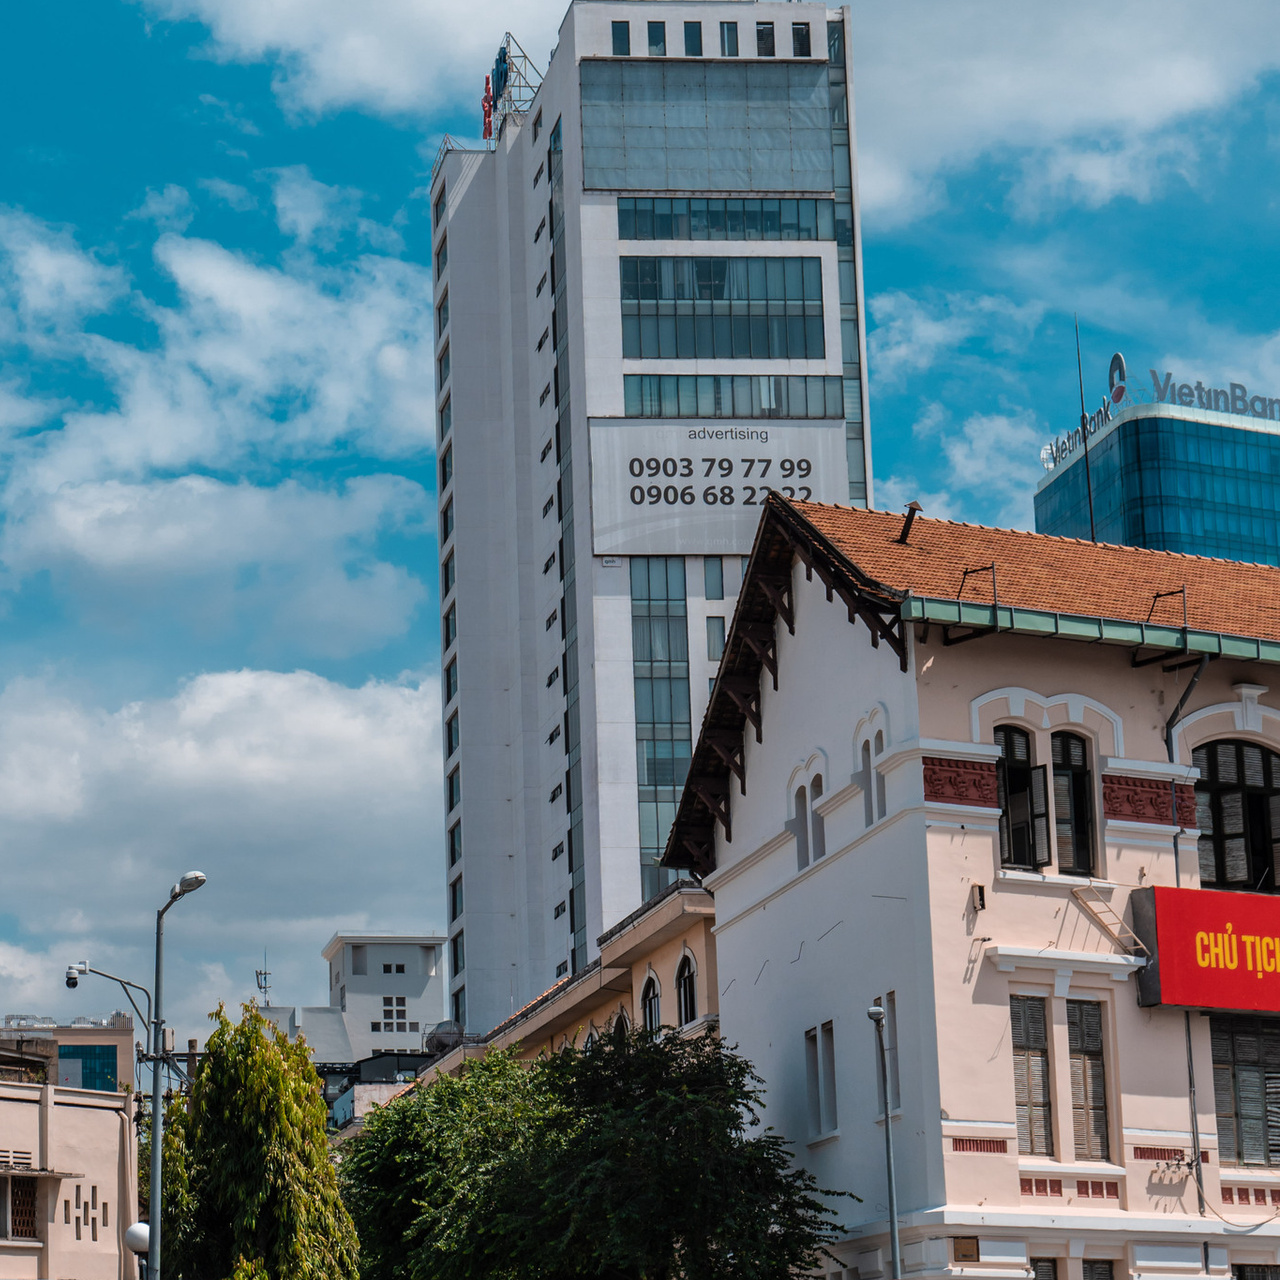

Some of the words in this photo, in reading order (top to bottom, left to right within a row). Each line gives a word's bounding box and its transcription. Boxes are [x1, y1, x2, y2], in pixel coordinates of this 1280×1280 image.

[688, 428, 769, 443] advertising
[1050, 396, 1113, 468] VietinBank
[629, 458, 694, 477] 0903
[701, 458, 733, 477] 79
[741, 459, 772, 478] 77
[780, 459, 812, 478] 99
[630, 485, 695, 505] 0906
[703, 485, 735, 505] 68
[742, 486, 772, 505] 22
[1196, 922, 1238, 970] CHỦ
